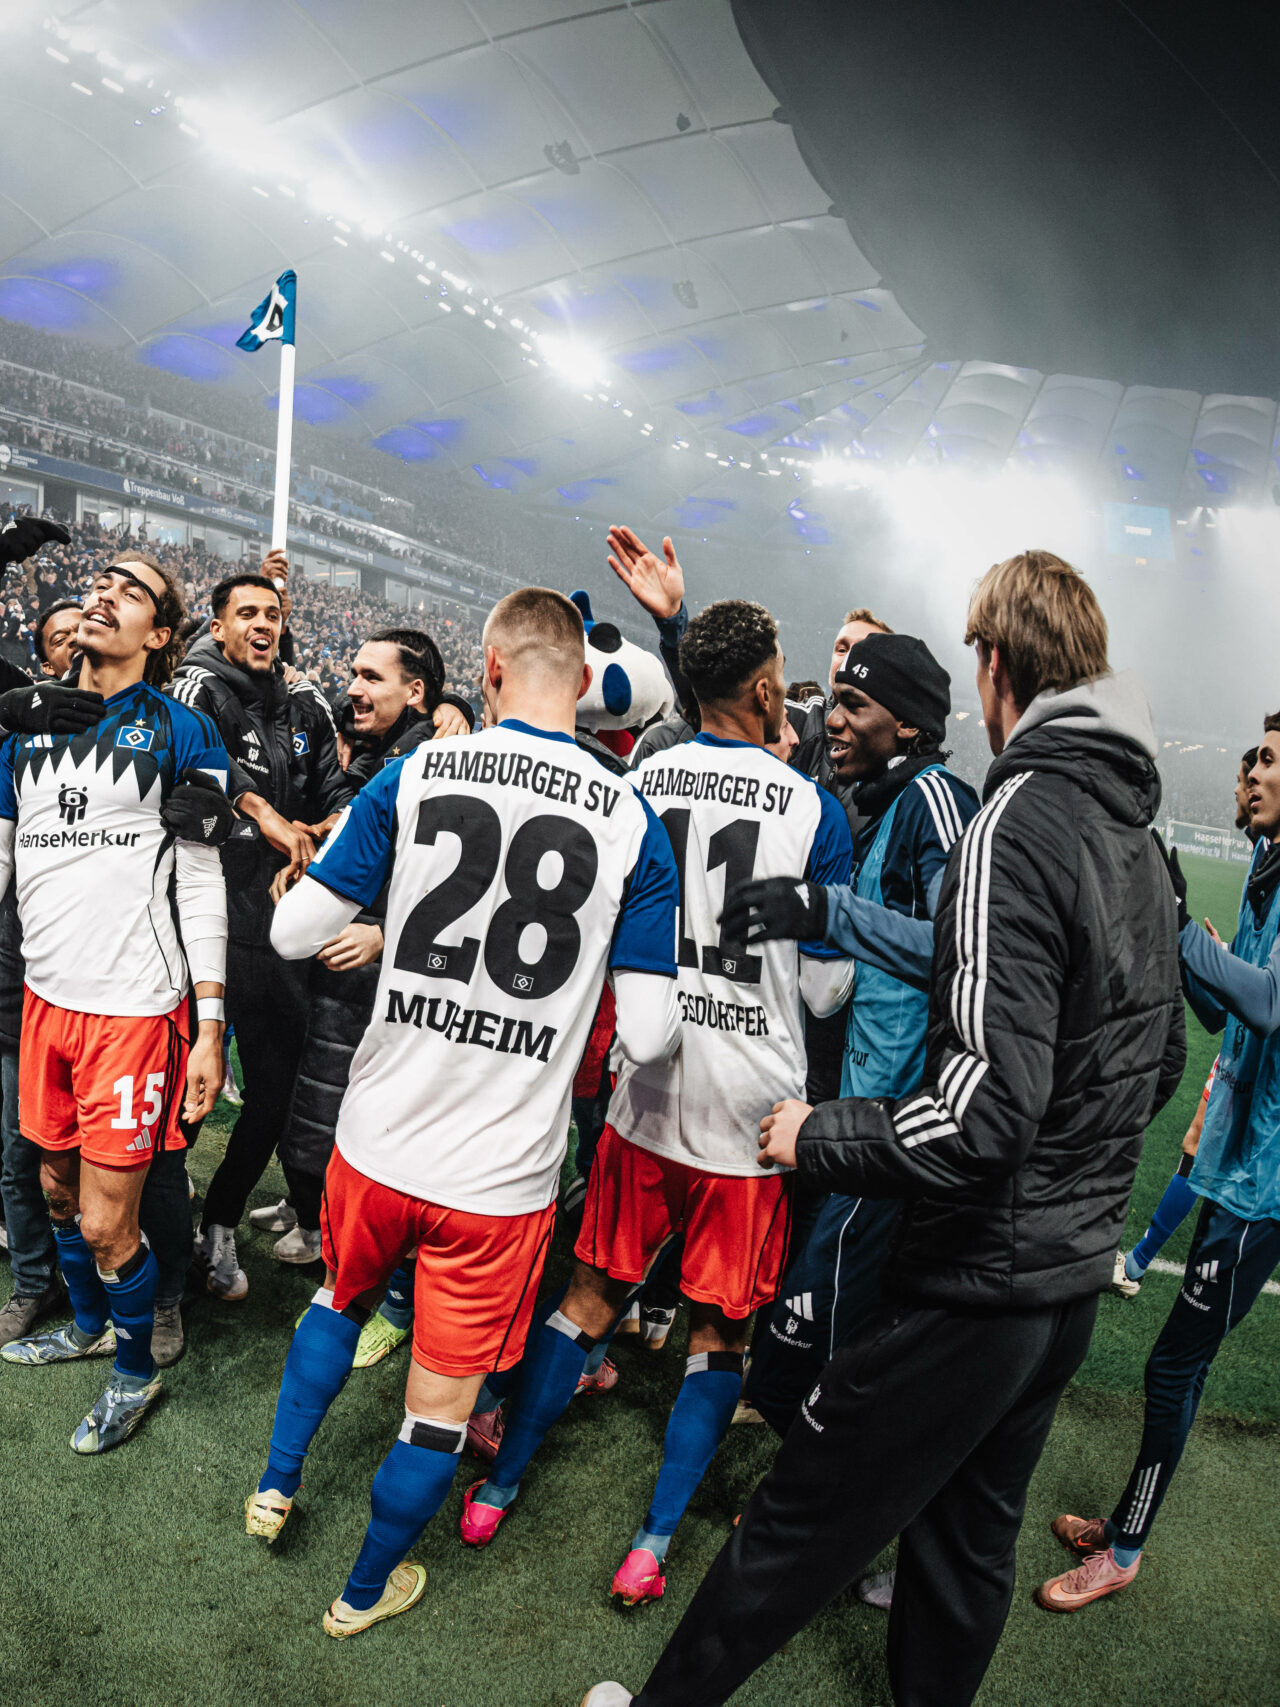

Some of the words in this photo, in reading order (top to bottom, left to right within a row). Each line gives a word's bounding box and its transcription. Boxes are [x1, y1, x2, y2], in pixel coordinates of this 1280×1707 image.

[129, 482, 171, 503] Treppenbau
[172, 493, 186, 506] Voß
[852, 662, 869, 680] 45
[421, 750, 582, 804] HAMBURGER
[583, 779, 621, 818] SV
[639, 767, 761, 808] HAMBURGER
[762, 783, 794, 816] SV
[19, 829, 141, 850] HanseMerkur
[393, 793, 599, 1001] 28
[384, 988, 558, 1064] MUHEIM
[110, 1071, 165, 1130] 15
